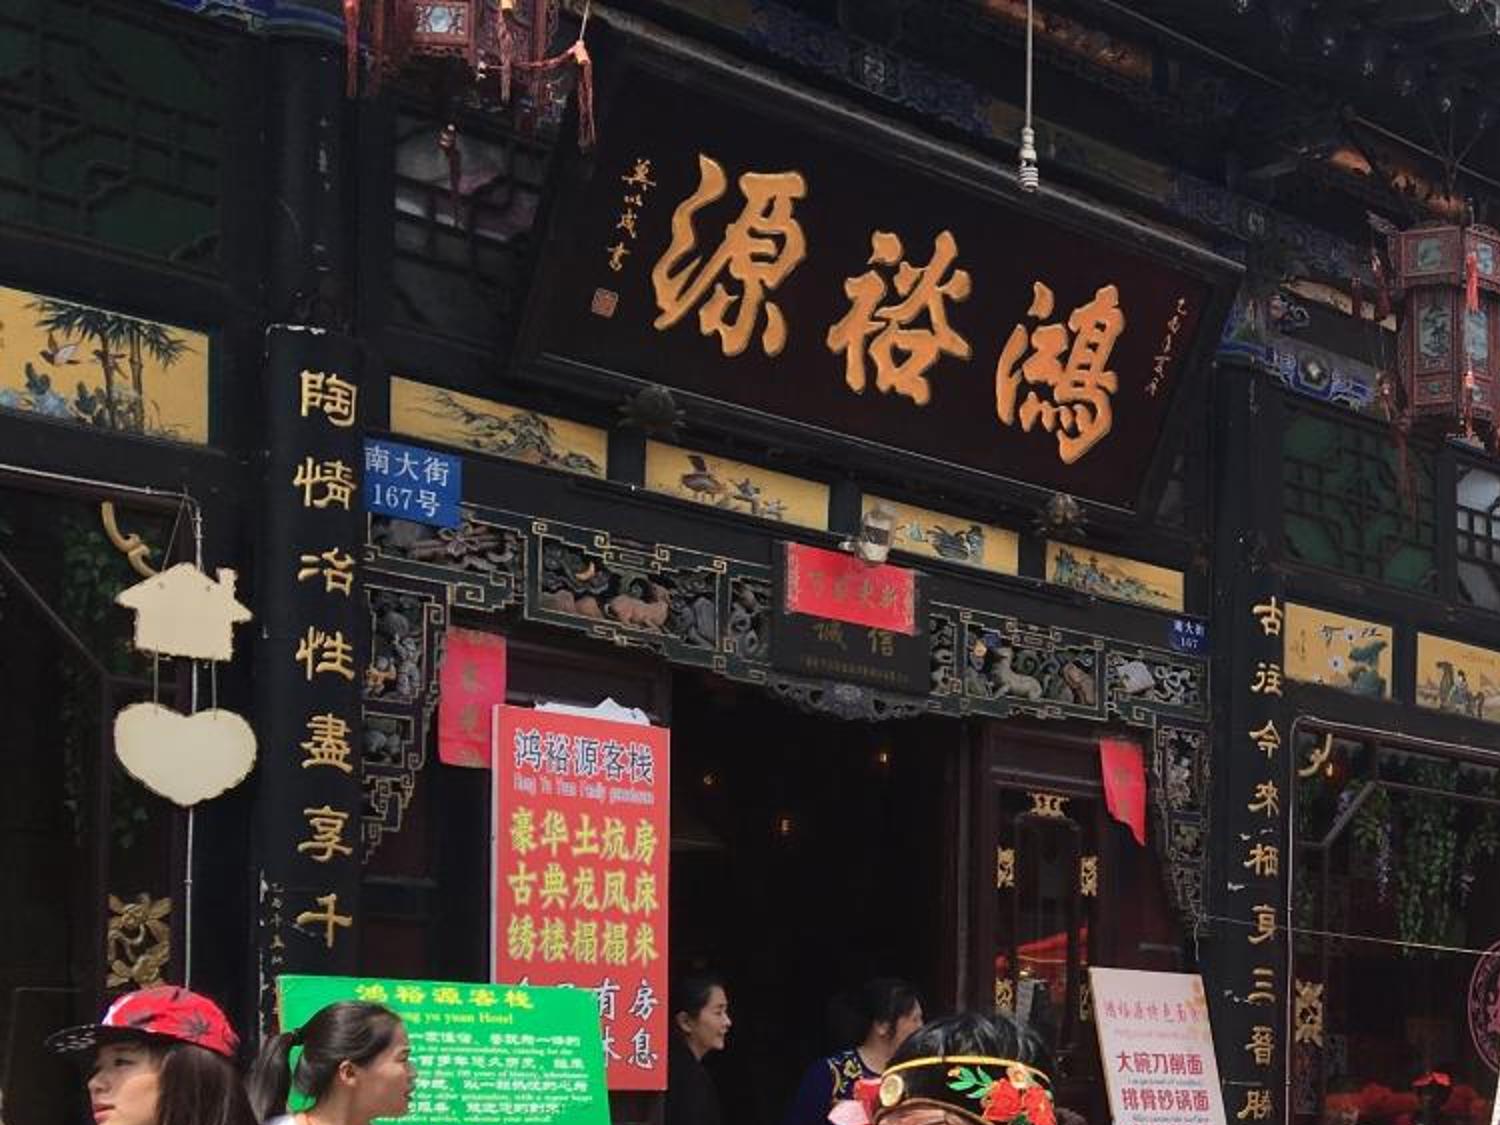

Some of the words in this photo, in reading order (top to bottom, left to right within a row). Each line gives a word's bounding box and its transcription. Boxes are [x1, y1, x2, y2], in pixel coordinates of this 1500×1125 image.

[365, 446, 449, 488] 南大街
[372, 483, 441, 518] 167号
[515, 728, 655, 784] 鸿裕源客栈
[511, 806, 658, 865] 豪华土炕房
[507, 863, 659, 917] 古典龙凤床
[507, 914, 659, 968] 绣楼榻榻米
[1116, 1051, 1204, 1076] 大碗刀削面
[1121, 1087, 1210, 1112] 排骨砂锅面
